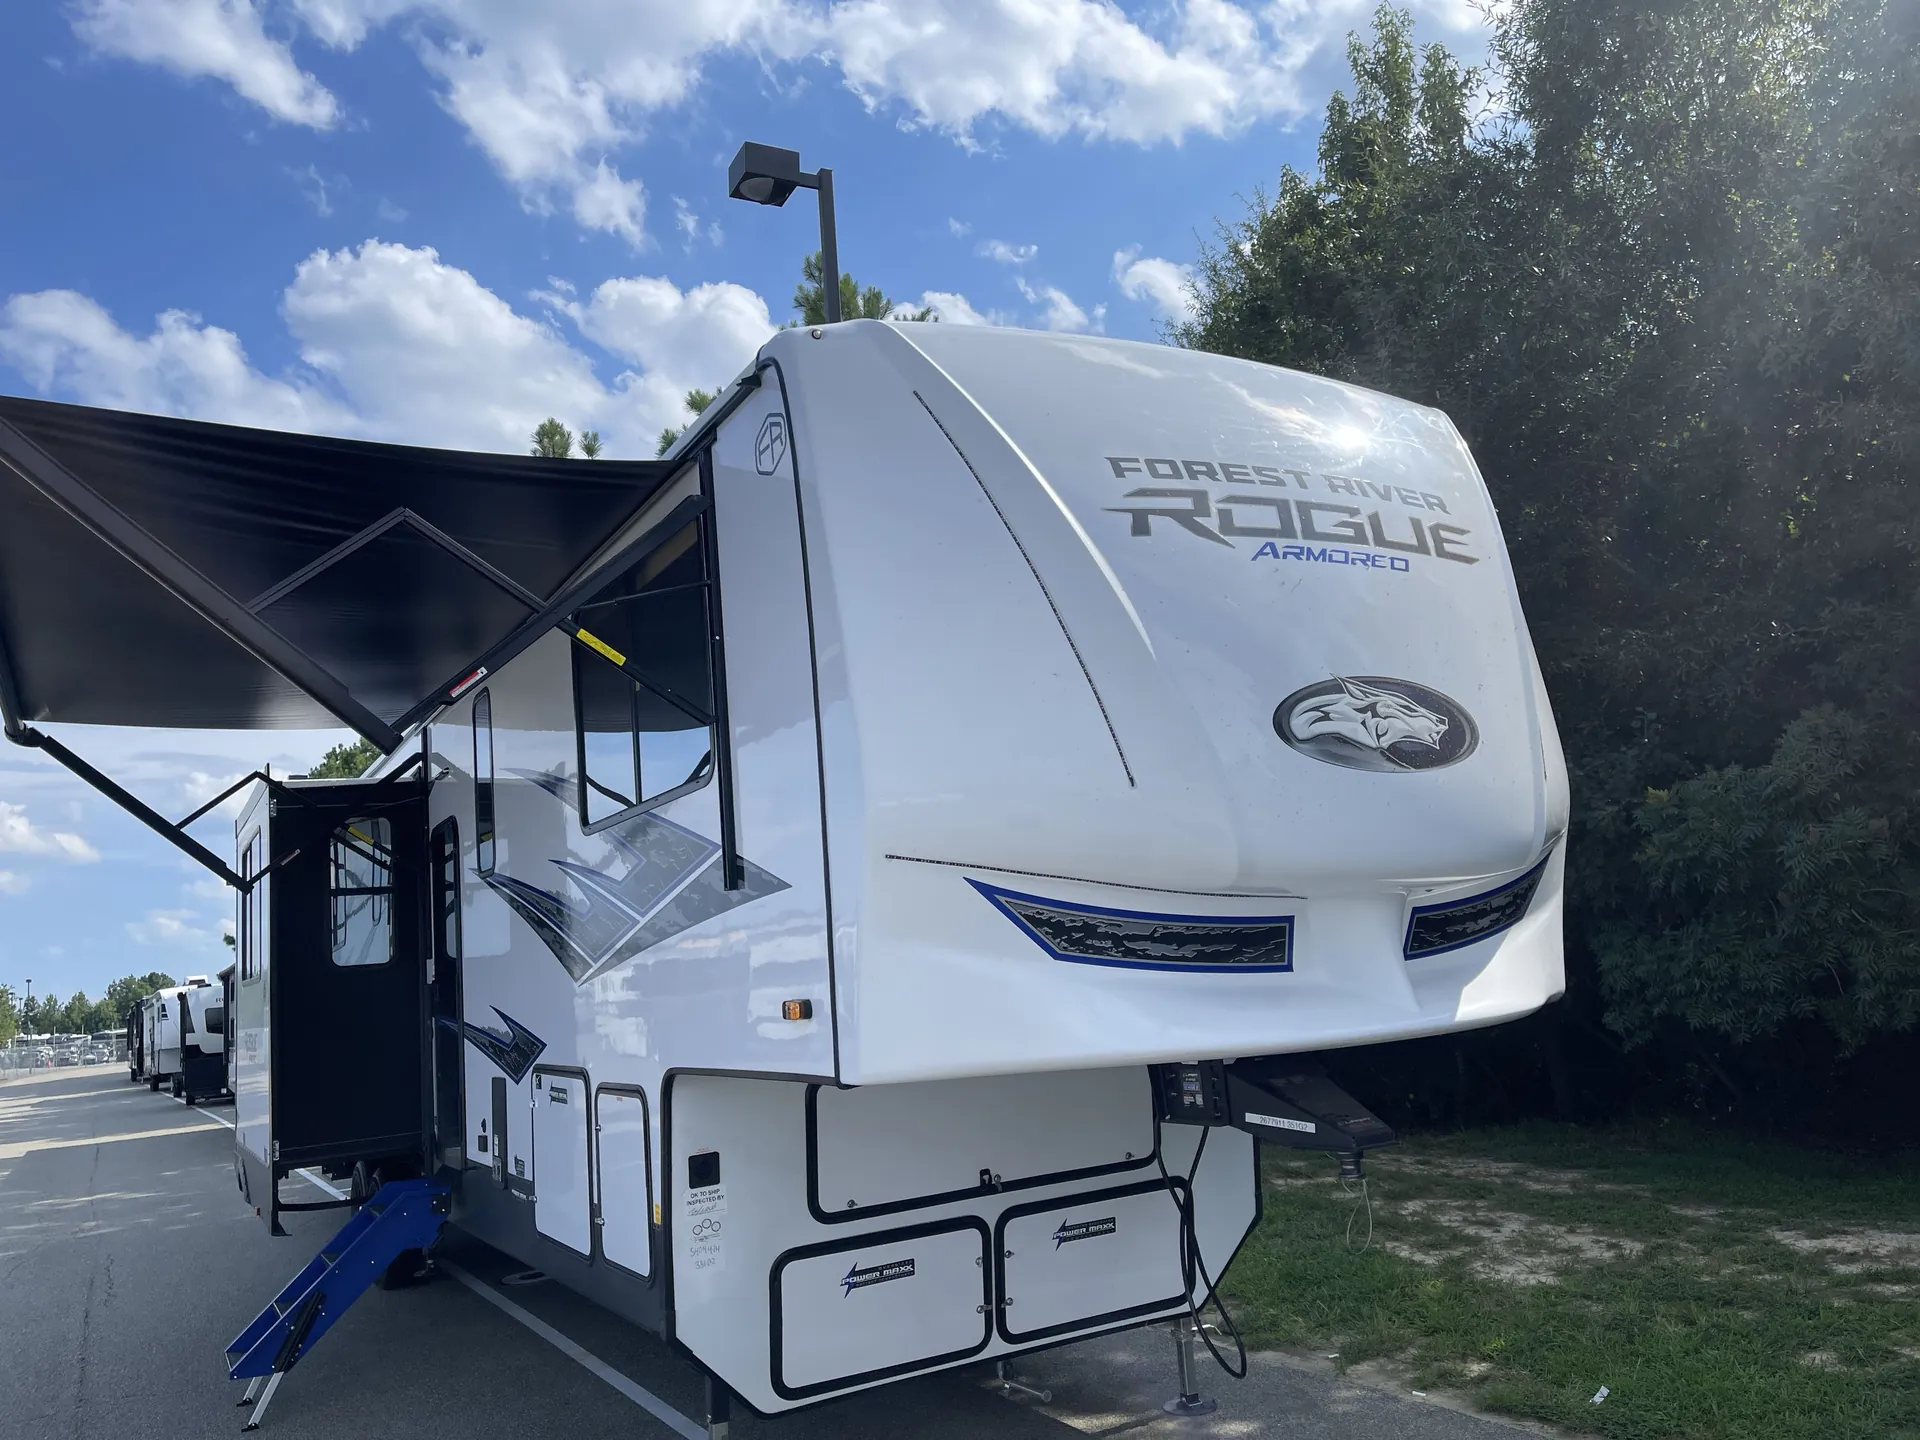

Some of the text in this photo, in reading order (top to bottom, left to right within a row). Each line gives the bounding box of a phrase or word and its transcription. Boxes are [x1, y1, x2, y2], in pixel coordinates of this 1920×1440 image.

[1104, 456, 1453, 516] FOREST RIVER
[1101, 487, 1480, 566] ROGUE
[686, 1196, 717, 1206] INSPECTED
[708, 1188, 721, 1196] SHIP
[1053, 1228, 1086, 1239] POWER
[1088, 1222, 1115, 1233] MAXX
[841, 1264, 914, 1285] POWER MAXX
